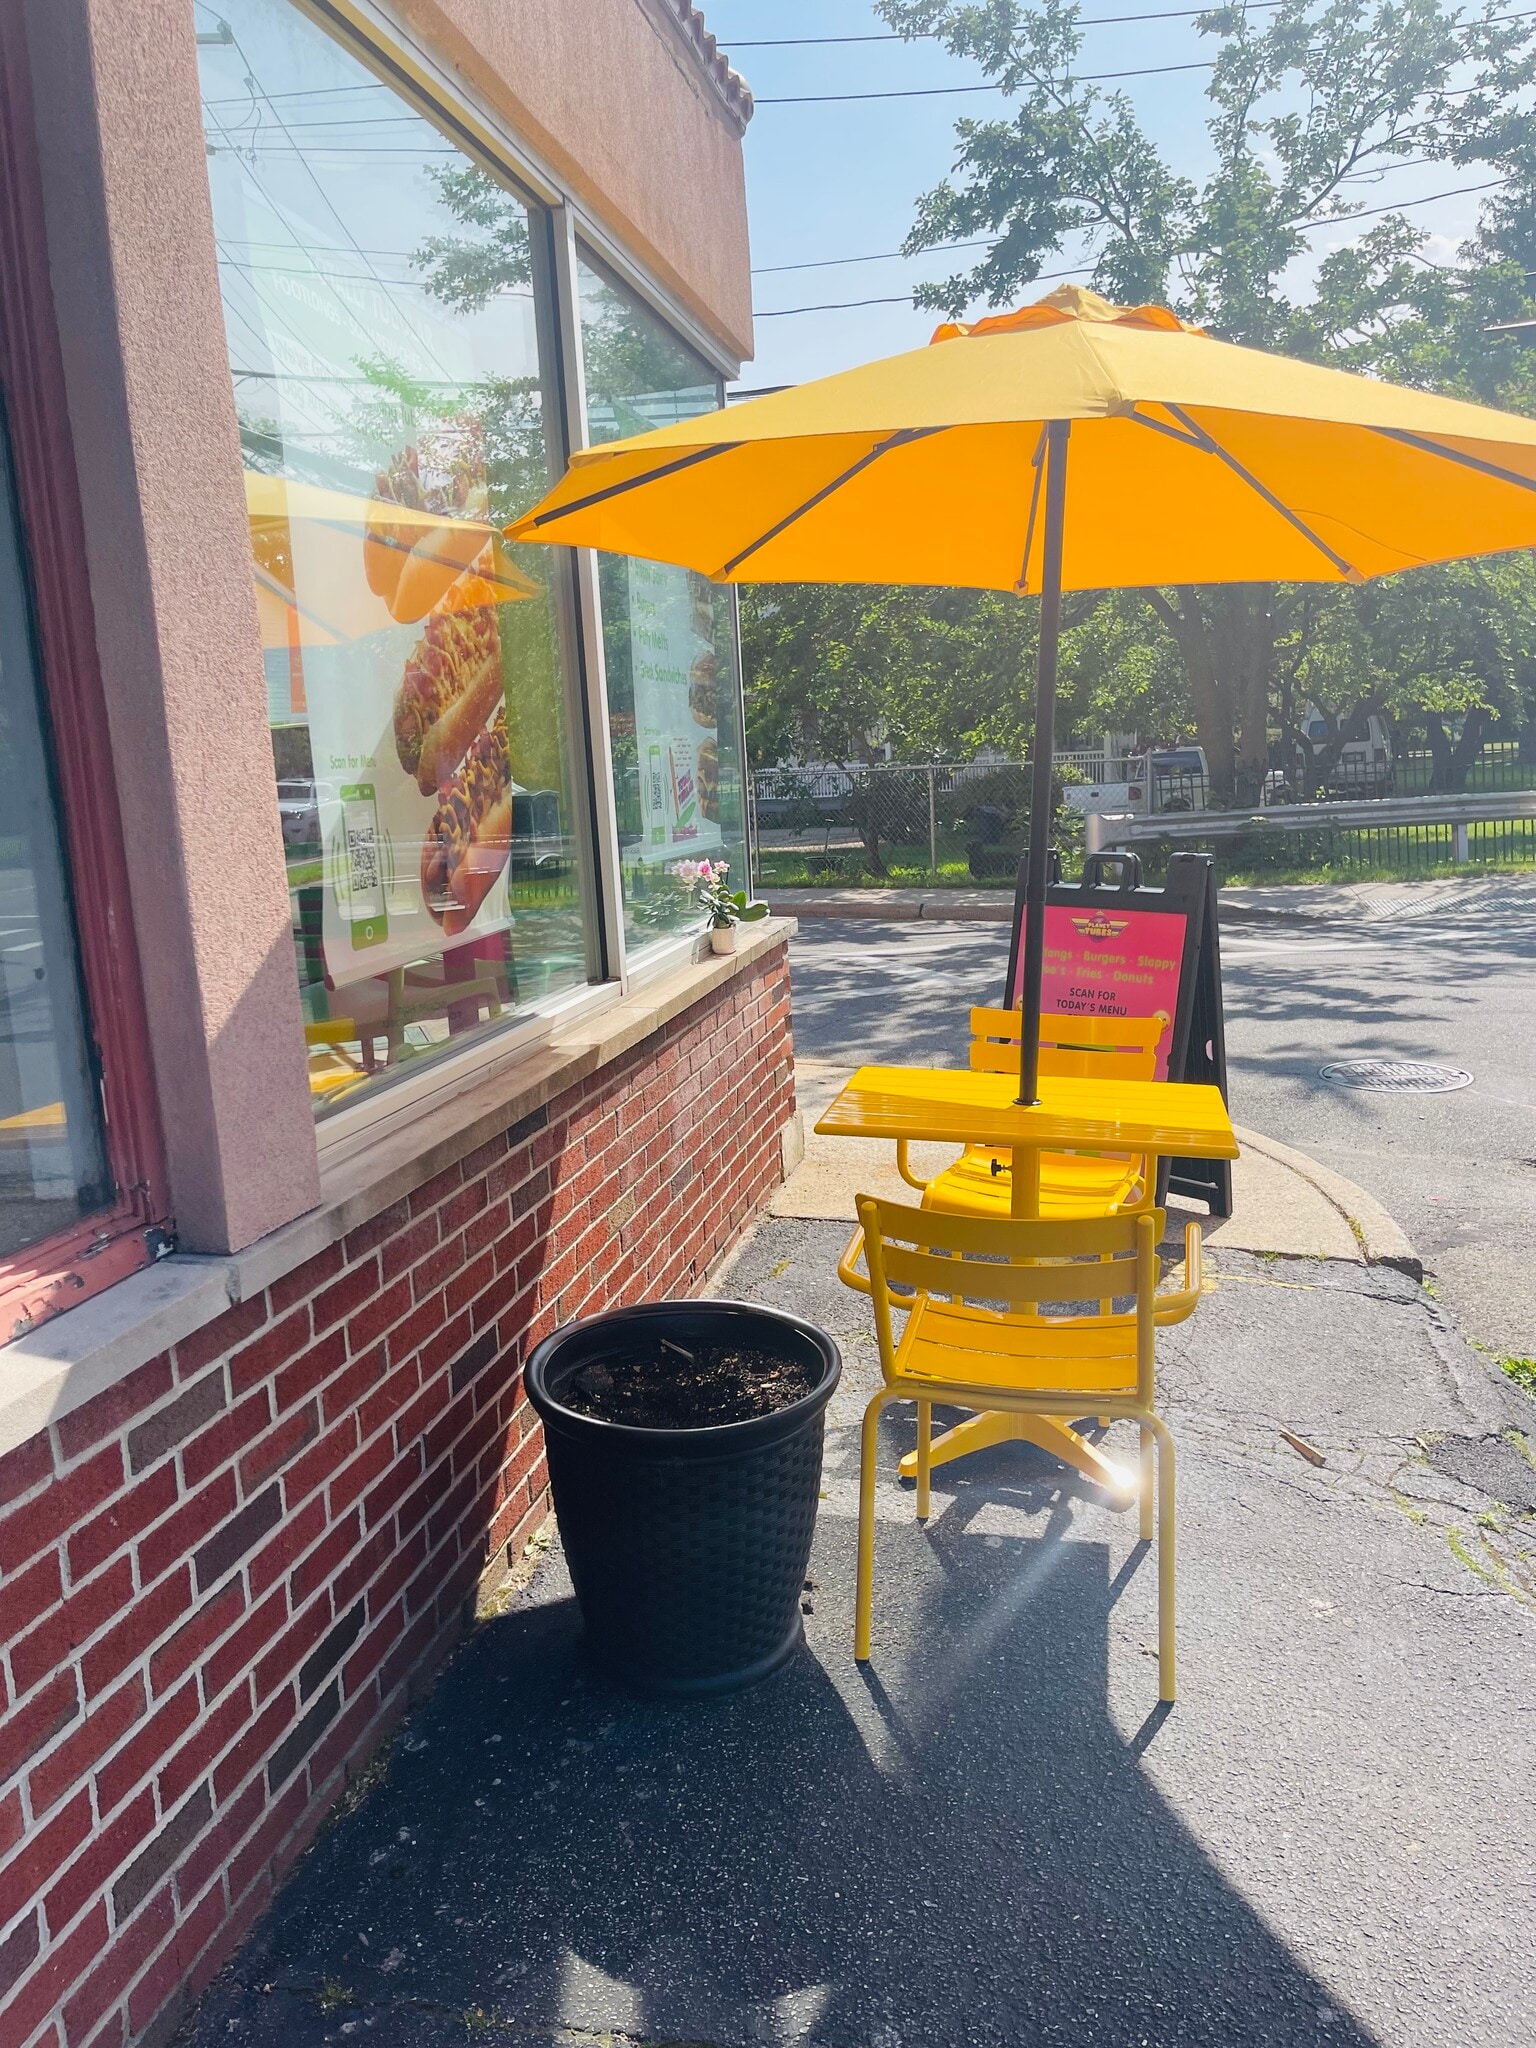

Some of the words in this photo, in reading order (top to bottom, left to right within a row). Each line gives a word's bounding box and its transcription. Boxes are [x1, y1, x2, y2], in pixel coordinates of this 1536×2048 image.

[655, 663, 688, 686] Sandwiches
[331, 755, 346, 769] Scan
[348, 755, 358, 769] for
[1084, 951, 1126, 965] Burgers
[1043, 965, 1066, 975] oe's
[1077, 968, 1102, 979] Fries
[1114, 971, 1153, 984] Donuts
[1069, 987, 1095, 999] SCAN
[1097, 990, 1116, 1001] FOR
[1056, 999, 1096, 1012] TODAY'S
[1098, 1004, 1128, 1016] MENU
